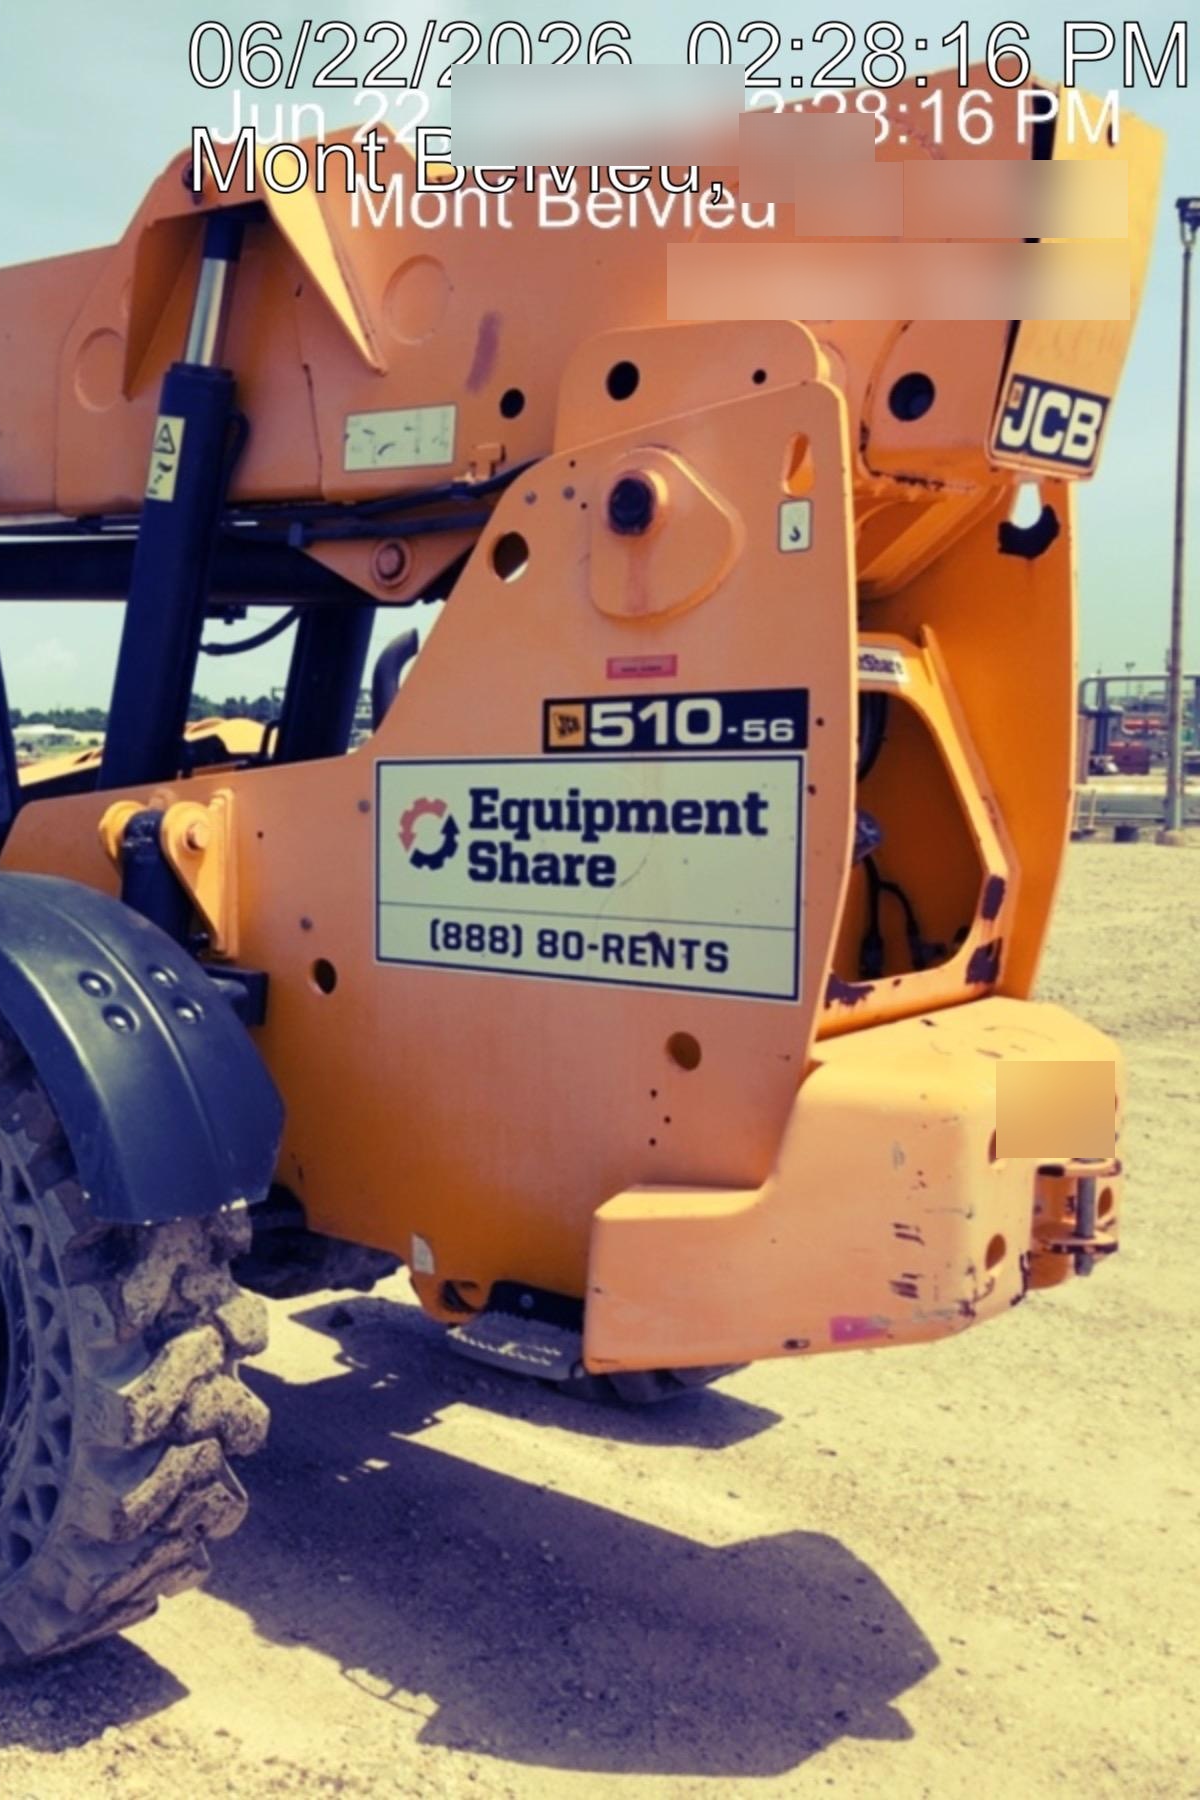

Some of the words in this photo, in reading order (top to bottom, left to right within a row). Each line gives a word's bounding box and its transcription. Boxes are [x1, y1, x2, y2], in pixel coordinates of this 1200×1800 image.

[1000, 384, 1103, 461] JCB
[468, 787, 769, 844] Equipment
[467, 839, 617, 889] Share
[430, 918, 523, 959] (888)
[536, 928, 730, 974] 80-RENTS
